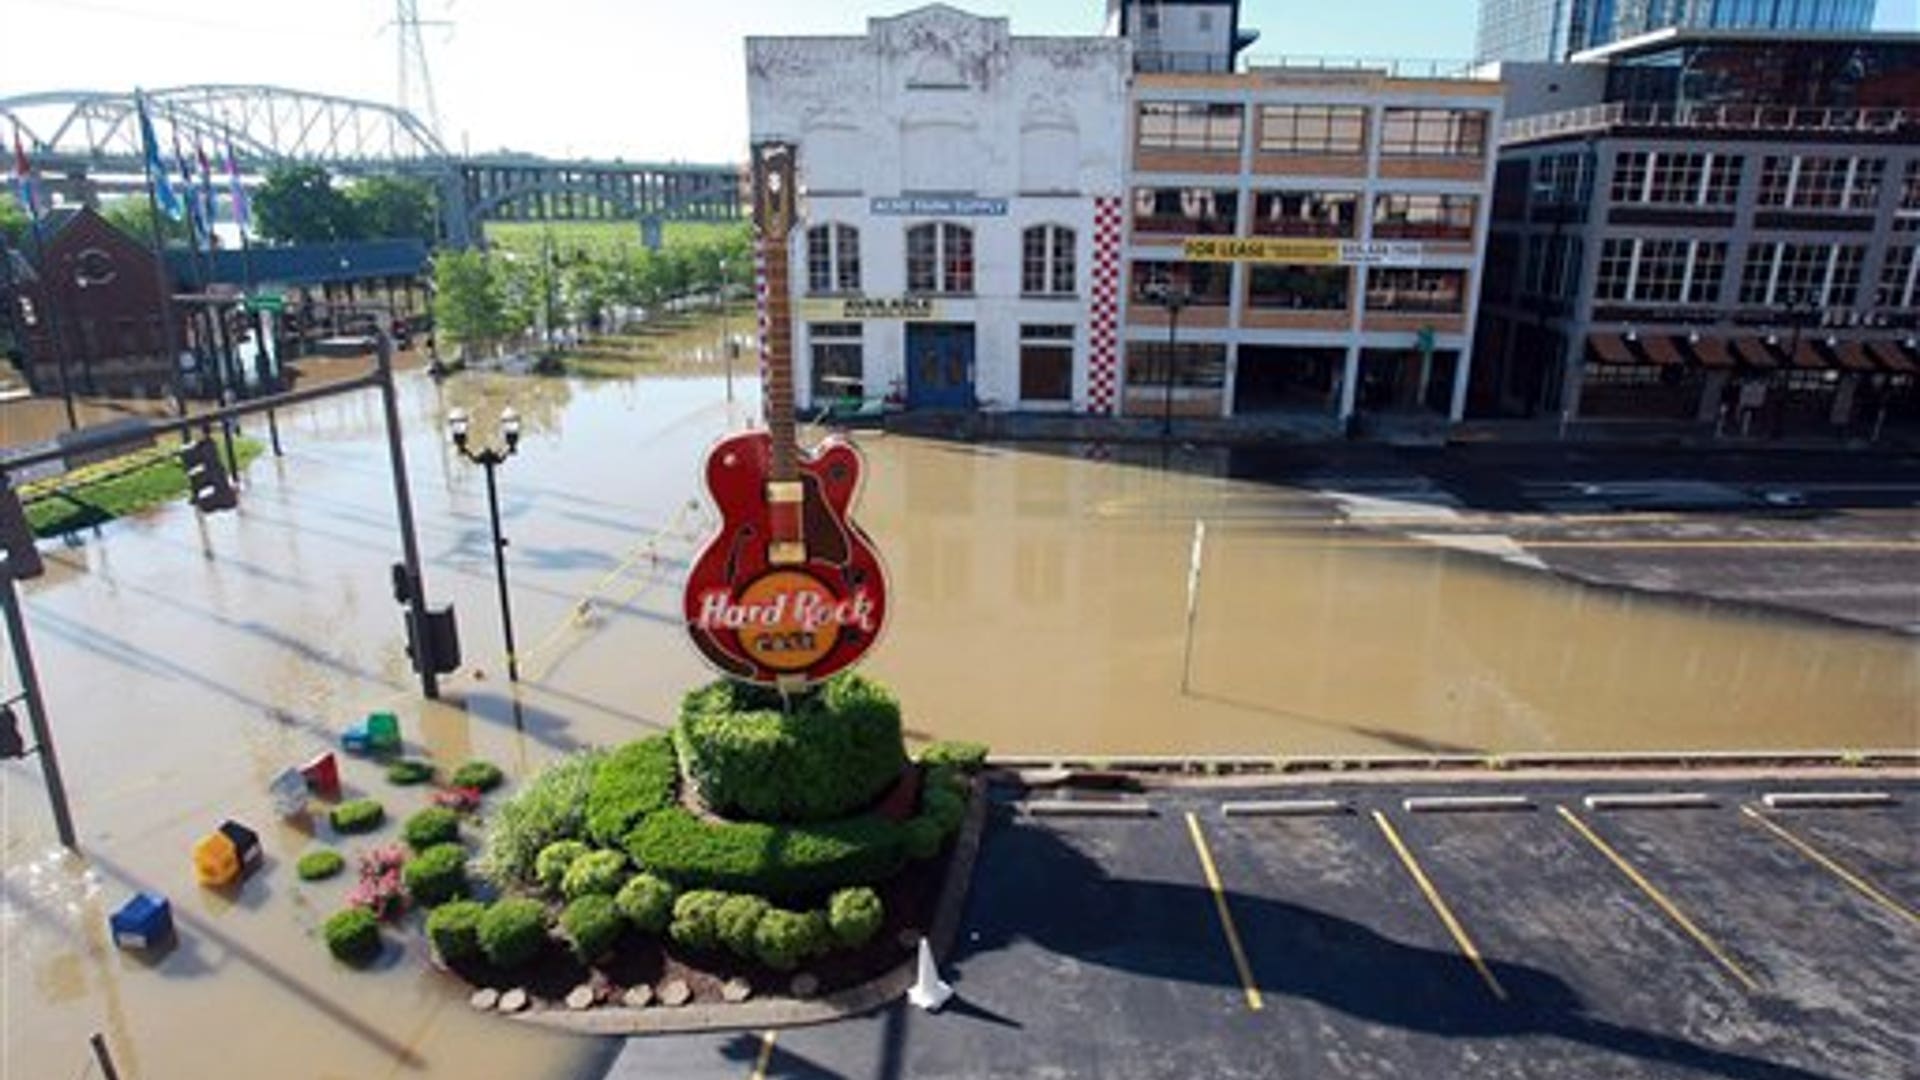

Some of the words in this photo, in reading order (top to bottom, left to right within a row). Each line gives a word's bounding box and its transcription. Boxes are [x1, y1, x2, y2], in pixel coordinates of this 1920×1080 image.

[1186, 241, 1216, 257] FOR
[1220, 241, 1264, 258] LEASE
[843, 299, 932, 312] AVAILABLE
[700, 591, 787, 628] Hard
[793, 589, 873, 632] Rock
